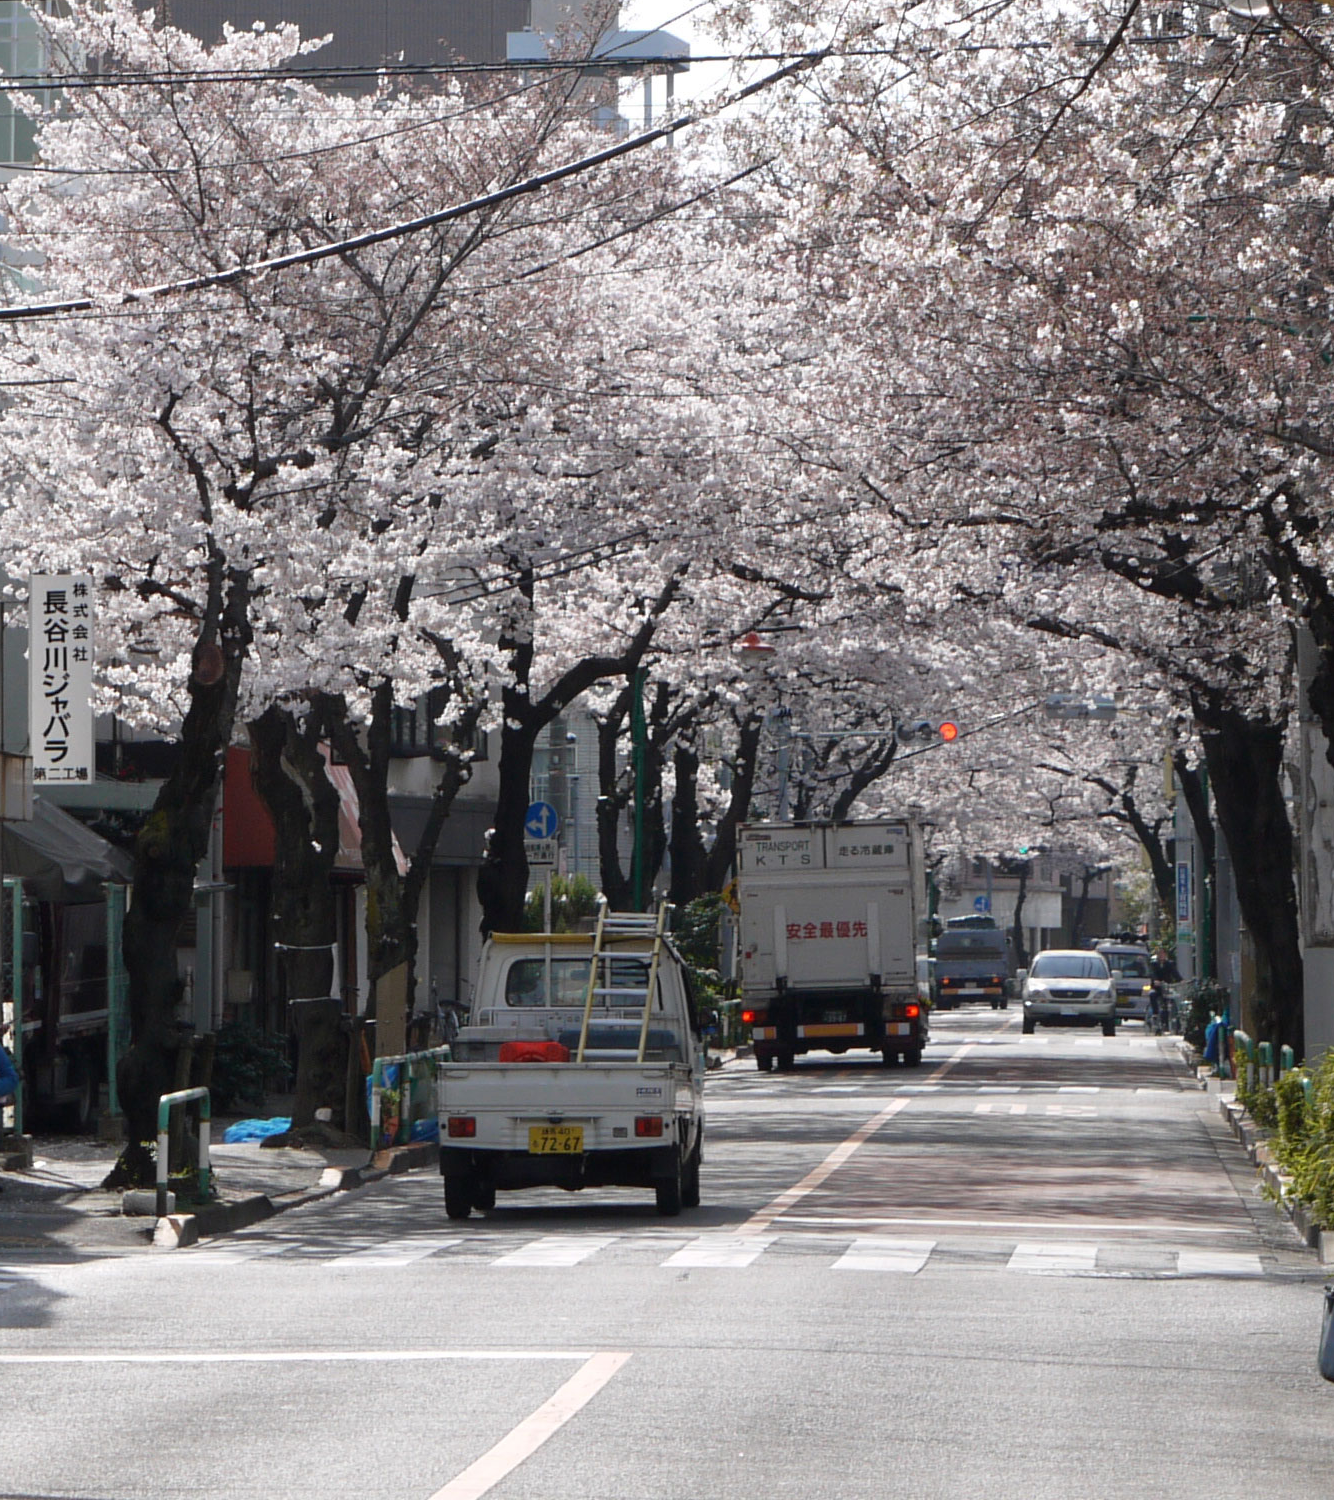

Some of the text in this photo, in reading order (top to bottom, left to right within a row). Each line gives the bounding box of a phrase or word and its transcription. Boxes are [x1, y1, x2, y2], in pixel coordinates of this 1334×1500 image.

[72, 581, 89, 662] 株式会社
[43, 589, 72, 763] 長谷川ジャバラ
[756, 840, 810, 852] TRANSPORT
[786, 920, 868, 940] 安全最優先
